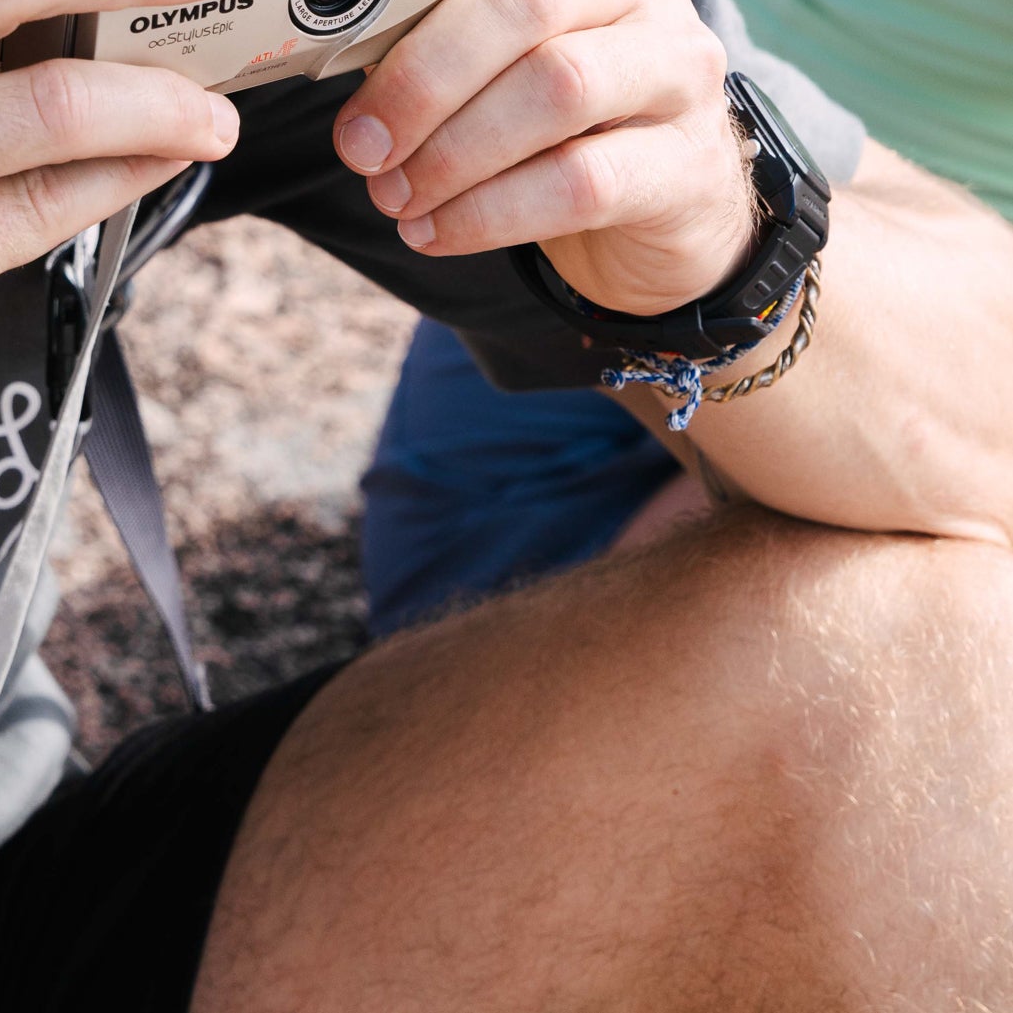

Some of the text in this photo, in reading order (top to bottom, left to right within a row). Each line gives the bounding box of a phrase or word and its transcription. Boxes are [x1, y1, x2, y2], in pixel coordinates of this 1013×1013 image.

[294, 0, 312, 22] LARGE
[313, 11, 355, 27] APERTURE
[248, 51, 273, 65] ULTI
